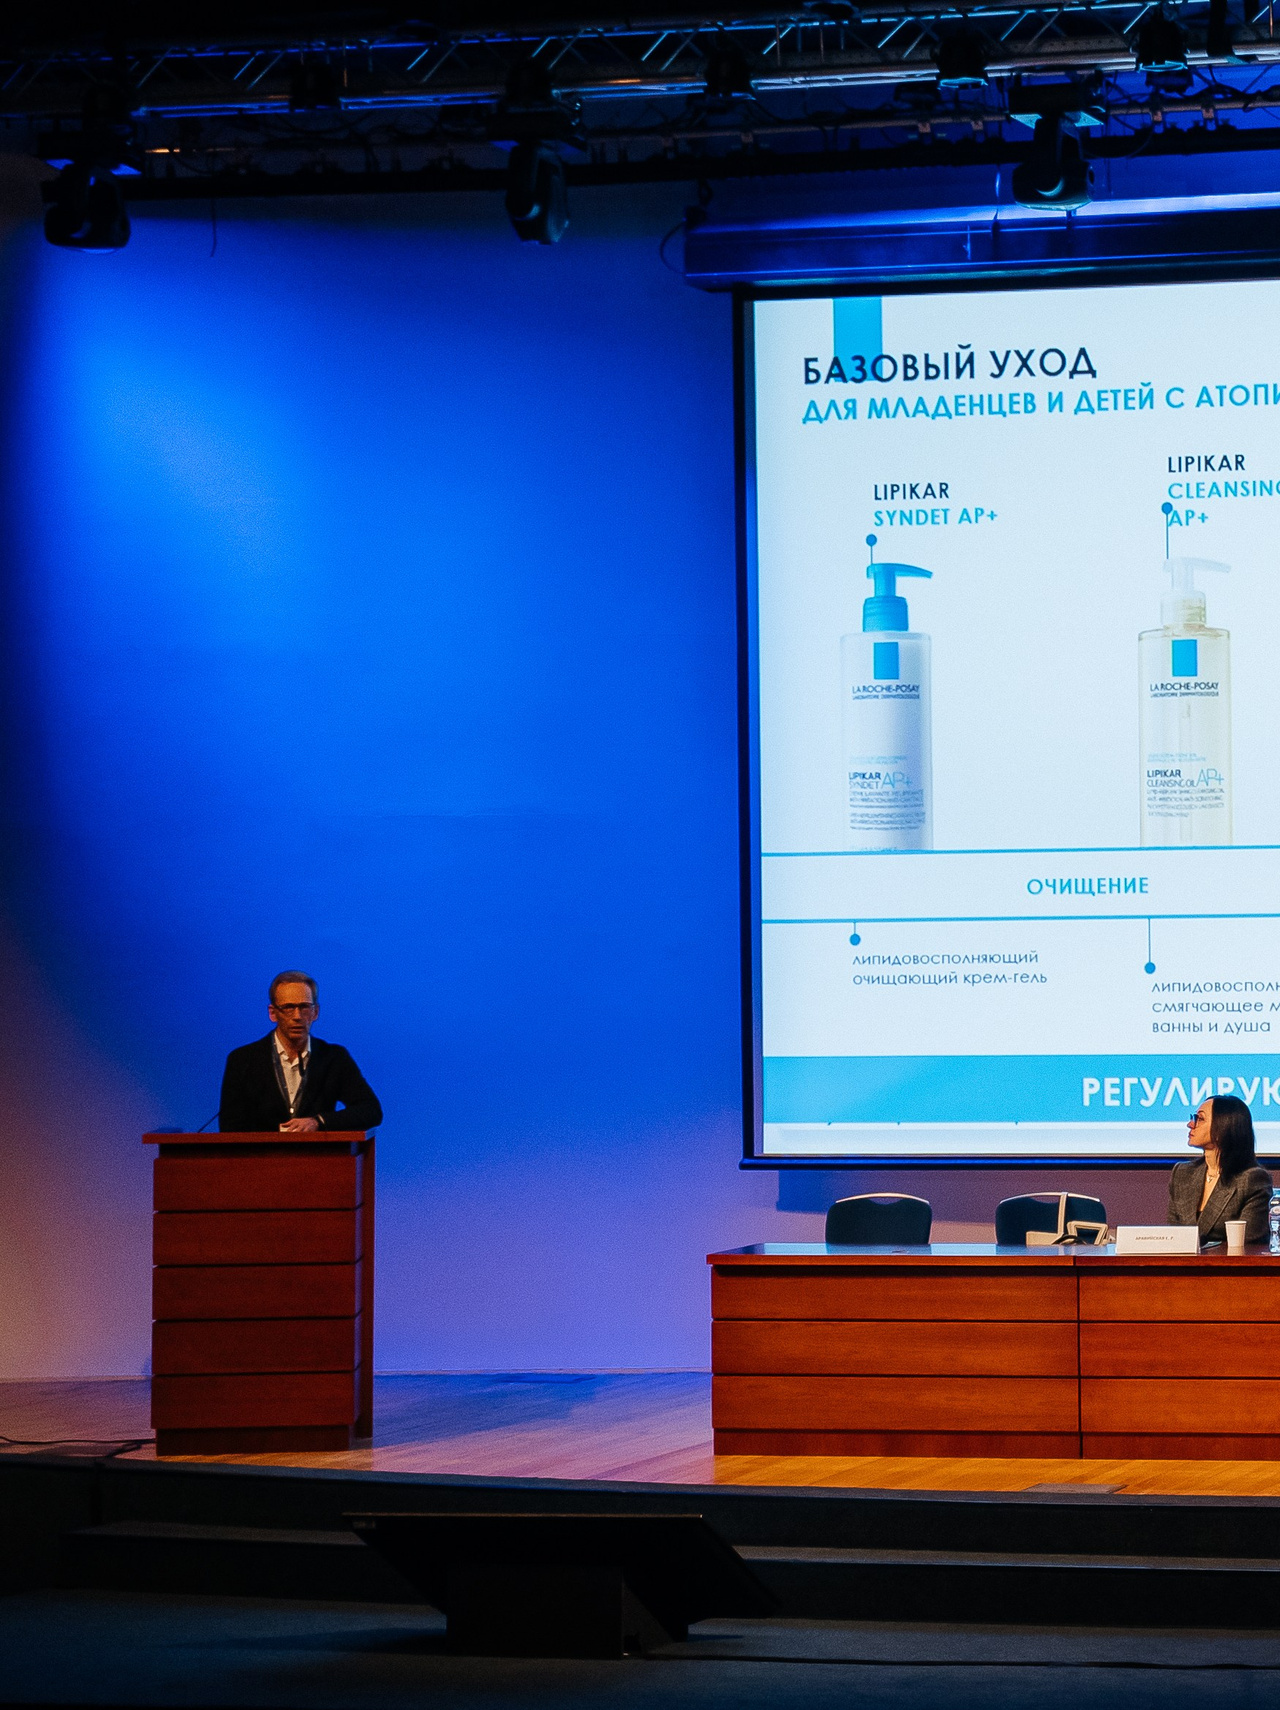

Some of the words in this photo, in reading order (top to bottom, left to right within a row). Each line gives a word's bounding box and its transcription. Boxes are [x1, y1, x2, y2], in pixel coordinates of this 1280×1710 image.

[804, 344, 974, 384] БАЗОВЫЙ
[990, 348, 1097, 379] УХОД
[802, 398, 857, 424] ДЛЯ
[868, 393, 1036, 420] МЛАДЕНЦЕВ
[1048, 391, 1063, 413] И
[1073, 381, 1154, 415] ДЕТЕЙ
[1166, 387, 1184, 408] С
[1168, 455, 1245, 473] LIPIKAR
[875, 482, 949, 500] LIPIKAR
[874, 508, 950, 526] SYNDET
[958, 508, 997, 524] AP+
[1169, 508, 1208, 526] AP+
[1147, 769, 1181, 778] LIPIKAR
[1027, 877, 1148, 896] ОЧИЩЕНИЕ
[853, 951, 1038, 966] липидовосполняющий
[853, 971, 957, 985] очищающий
[964, 973, 1047, 986] крем-гель
[1152, 1002, 1263, 1013] смягчающее
[1153, 1023, 1202, 1032] ванны
[1209, 1023, 1218, 1032] и
[1224, 1022, 1270, 1035] душа
